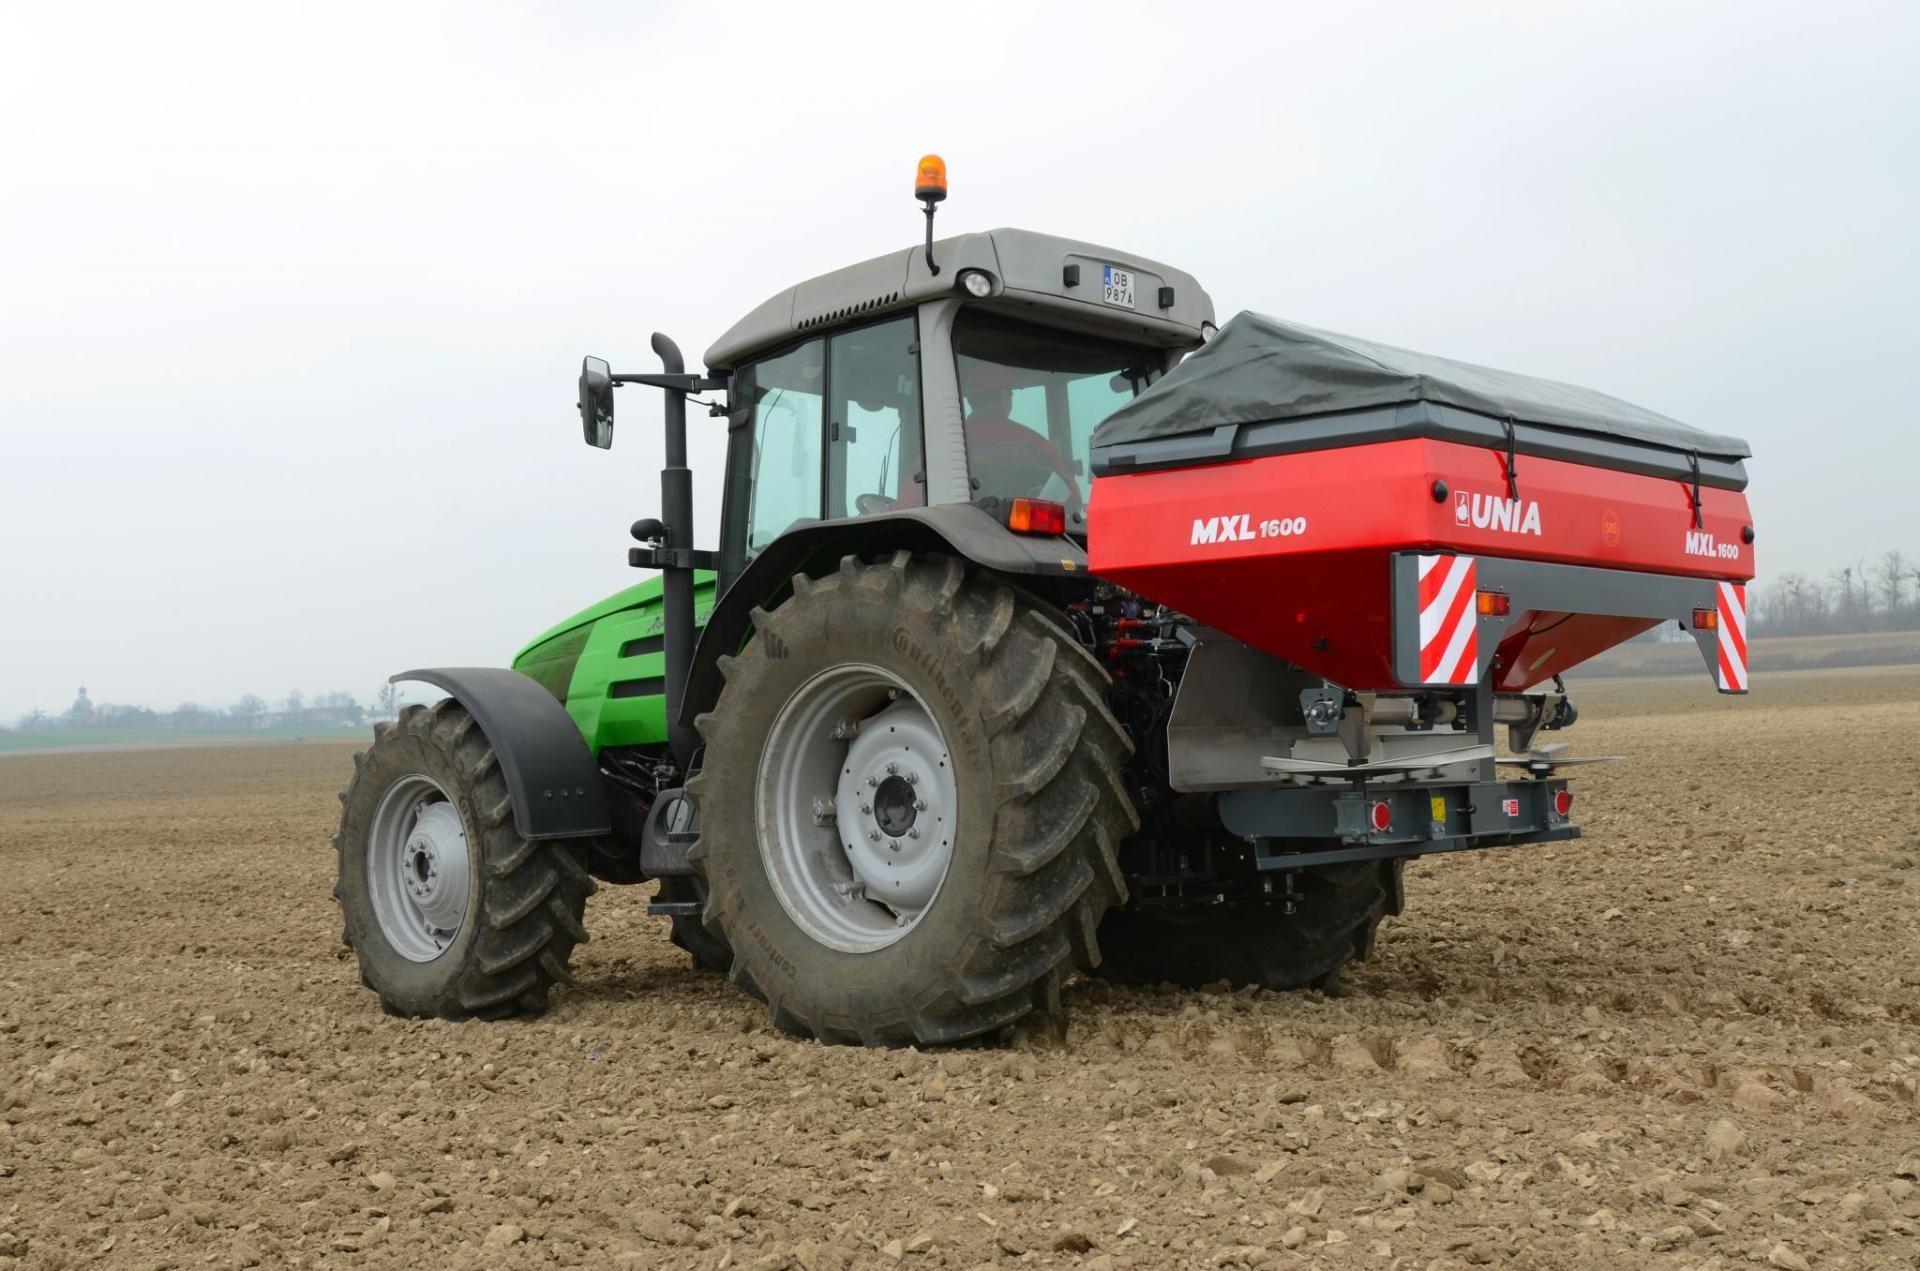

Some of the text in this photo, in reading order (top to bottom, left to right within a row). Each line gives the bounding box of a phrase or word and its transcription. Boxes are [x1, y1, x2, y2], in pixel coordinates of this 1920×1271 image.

[1114, 272, 1127, 287] OB
[1106, 287, 1133, 305] 987A
[1472, 493, 1542, 536] UNIA
[1190, 514, 1307, 545] MXL 1600
[1685, 531, 1739, 560] MXL 1600
